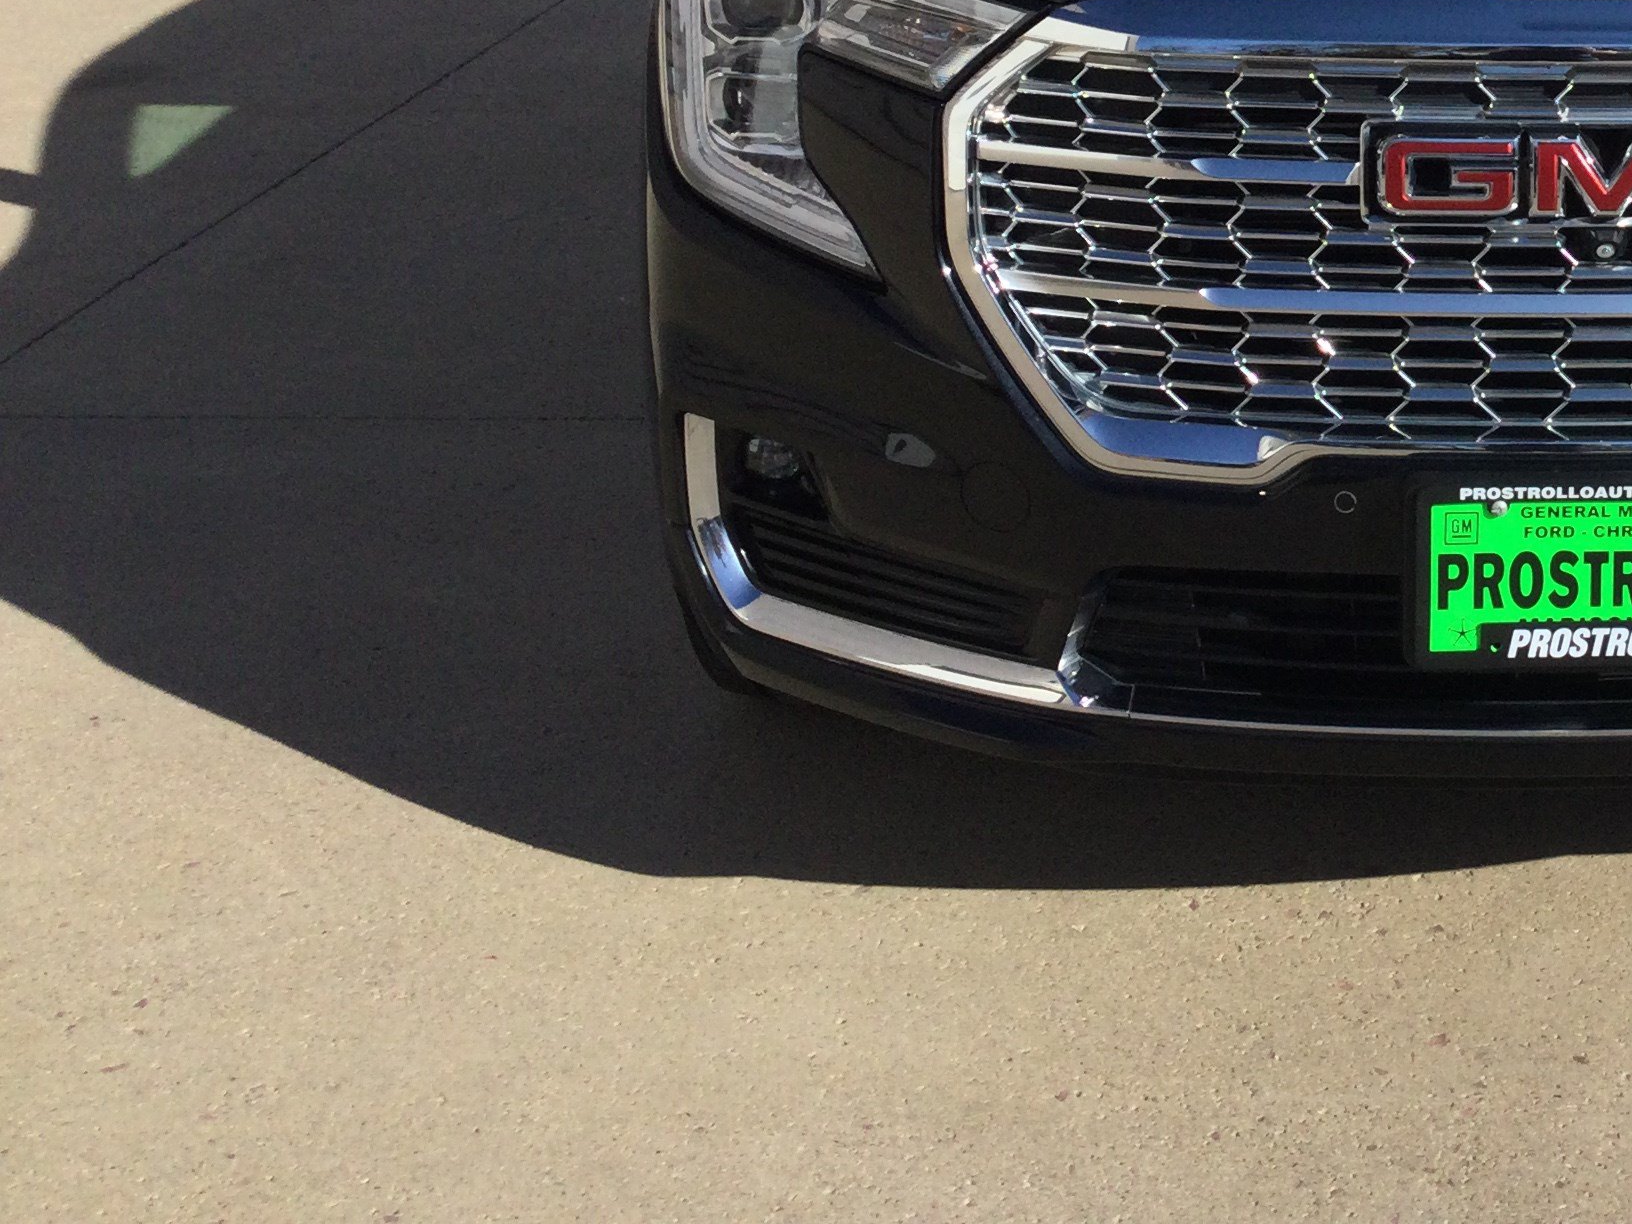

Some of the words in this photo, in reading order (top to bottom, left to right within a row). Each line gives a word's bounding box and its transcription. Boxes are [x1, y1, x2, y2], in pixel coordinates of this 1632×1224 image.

[1520, 505, 1611, 519] GENERAL
[1451, 518, 1473, 534] GM
[1523, 526, 1575, 539] FORD
